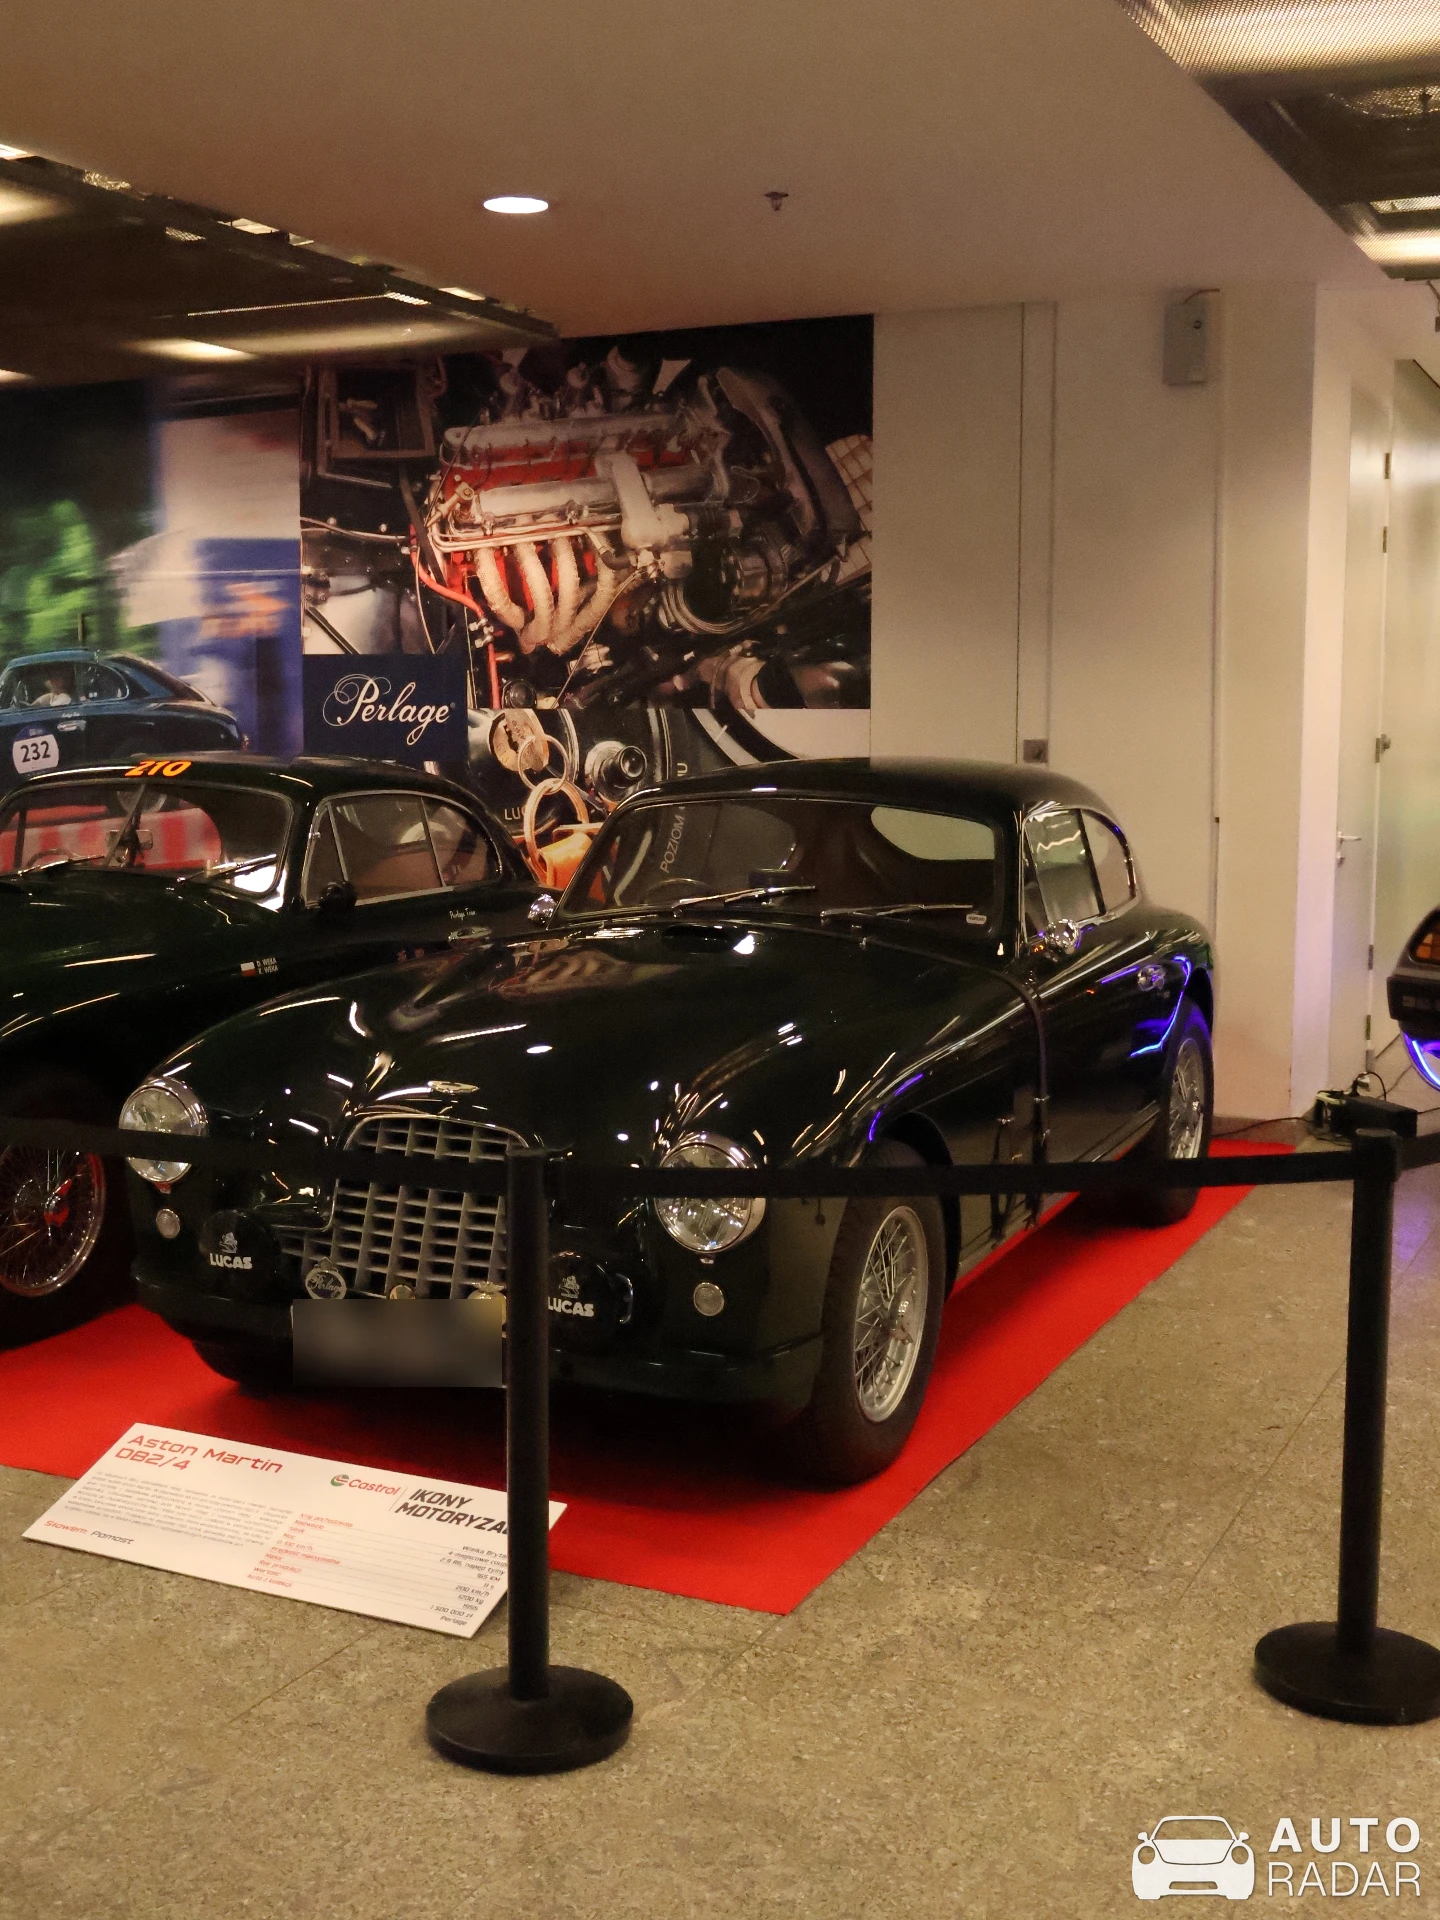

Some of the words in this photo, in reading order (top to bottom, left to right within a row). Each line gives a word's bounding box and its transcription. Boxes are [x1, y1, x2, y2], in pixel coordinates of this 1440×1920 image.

[322, 673, 450, 746] Perlage
[20, 740, 51, 763] 232
[125, 759, 192, 777] 210
[504, 808, 525, 821] LU
[659, 813, 686, 874] POZIOM
[209, 1252, 253, 1270] LUCAS
[547, 1296, 595, 1318] LUCAS
[114, 1447, 191, 1471] DB2/4
[127, 1435, 199, 1457] Aston
[202, 1448, 284, 1473] Martin
[348, 1478, 401, 1496] Castrol
[408, 1488, 473, 1510] IKONY
[90, 1529, 135, 1545] Pomost
